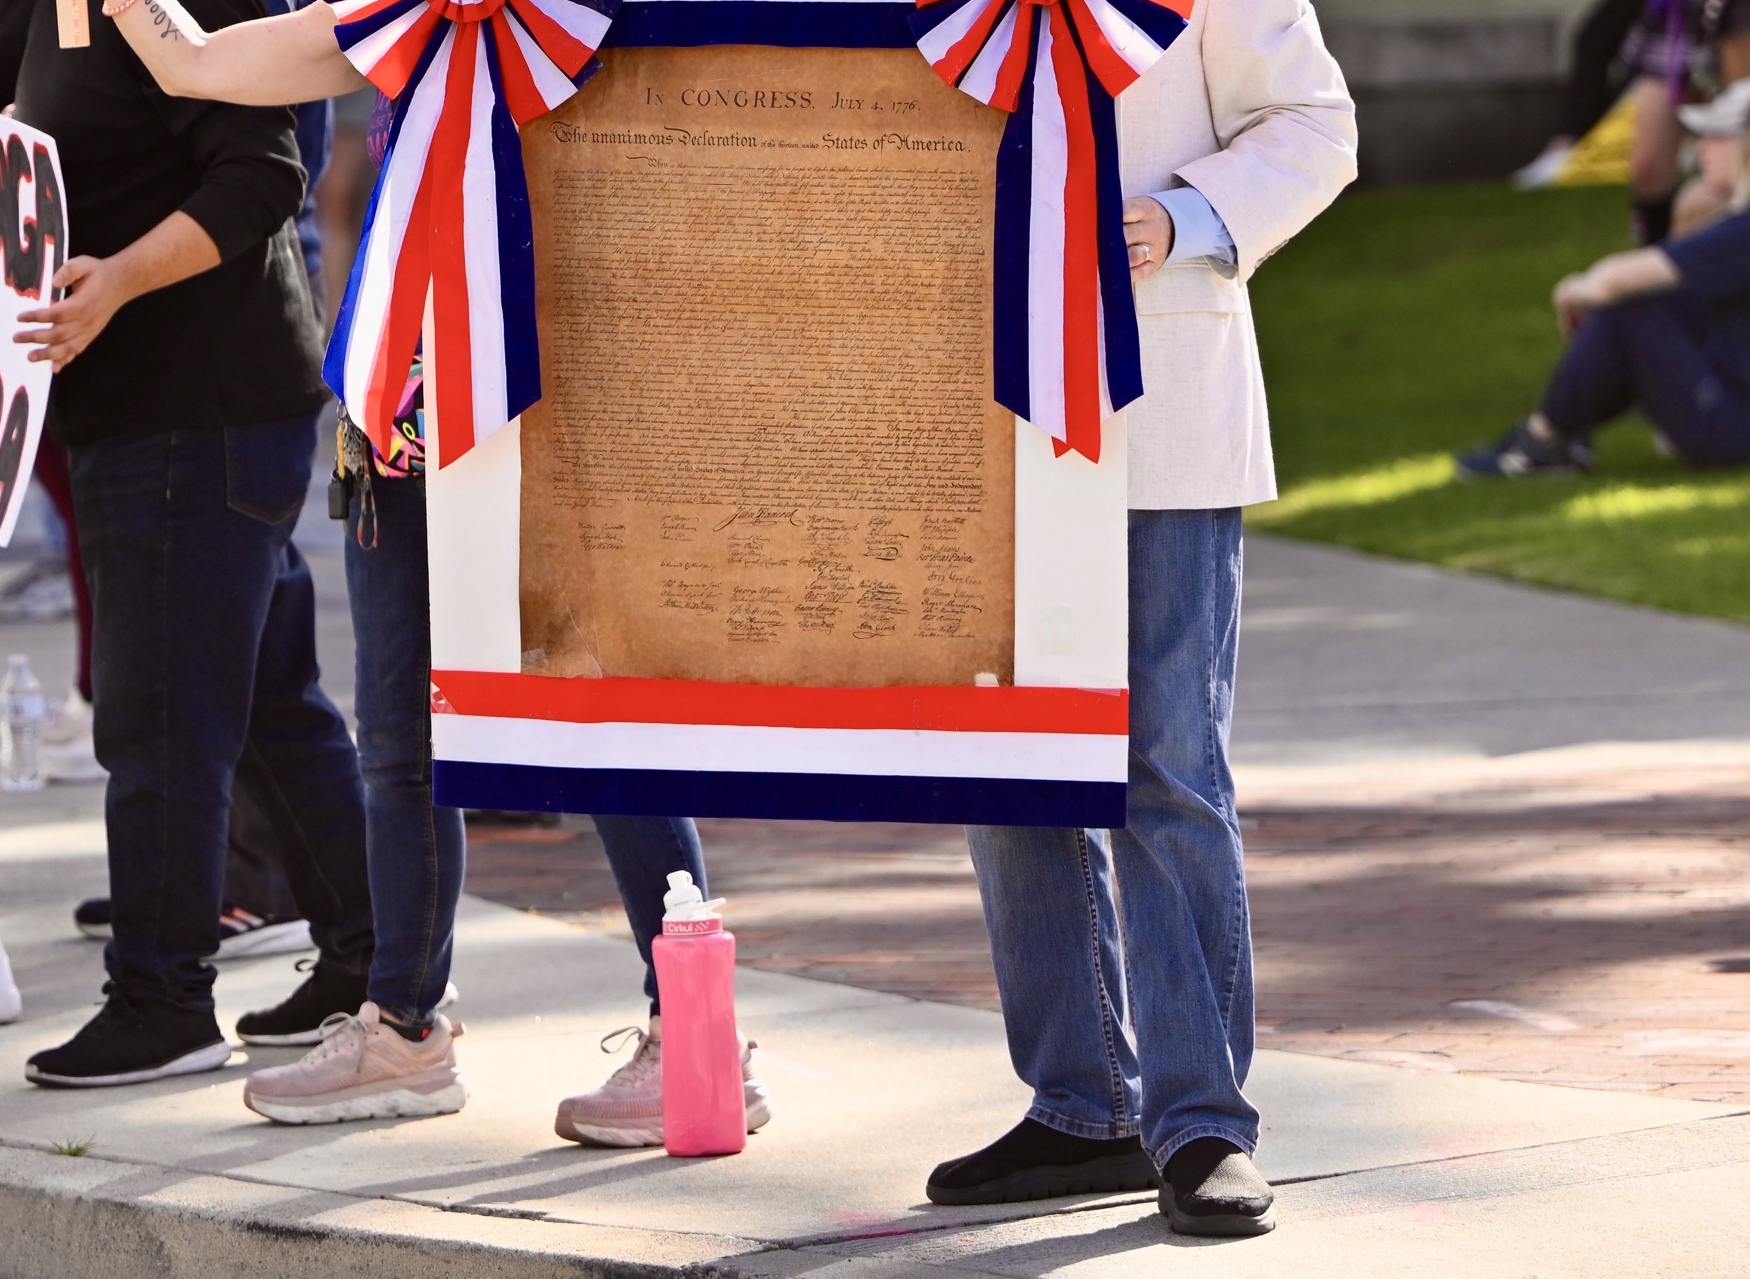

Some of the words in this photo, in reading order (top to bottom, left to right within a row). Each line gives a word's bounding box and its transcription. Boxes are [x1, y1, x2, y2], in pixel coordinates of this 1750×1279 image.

[550, 121, 588, 144] The
[591, 129, 675, 147] unanimous
[664, 125, 758, 149] Declaration
[822, 132, 868, 151] States
[872, 135, 886, 155] of
[667, 922, 693, 933] Cirkul
